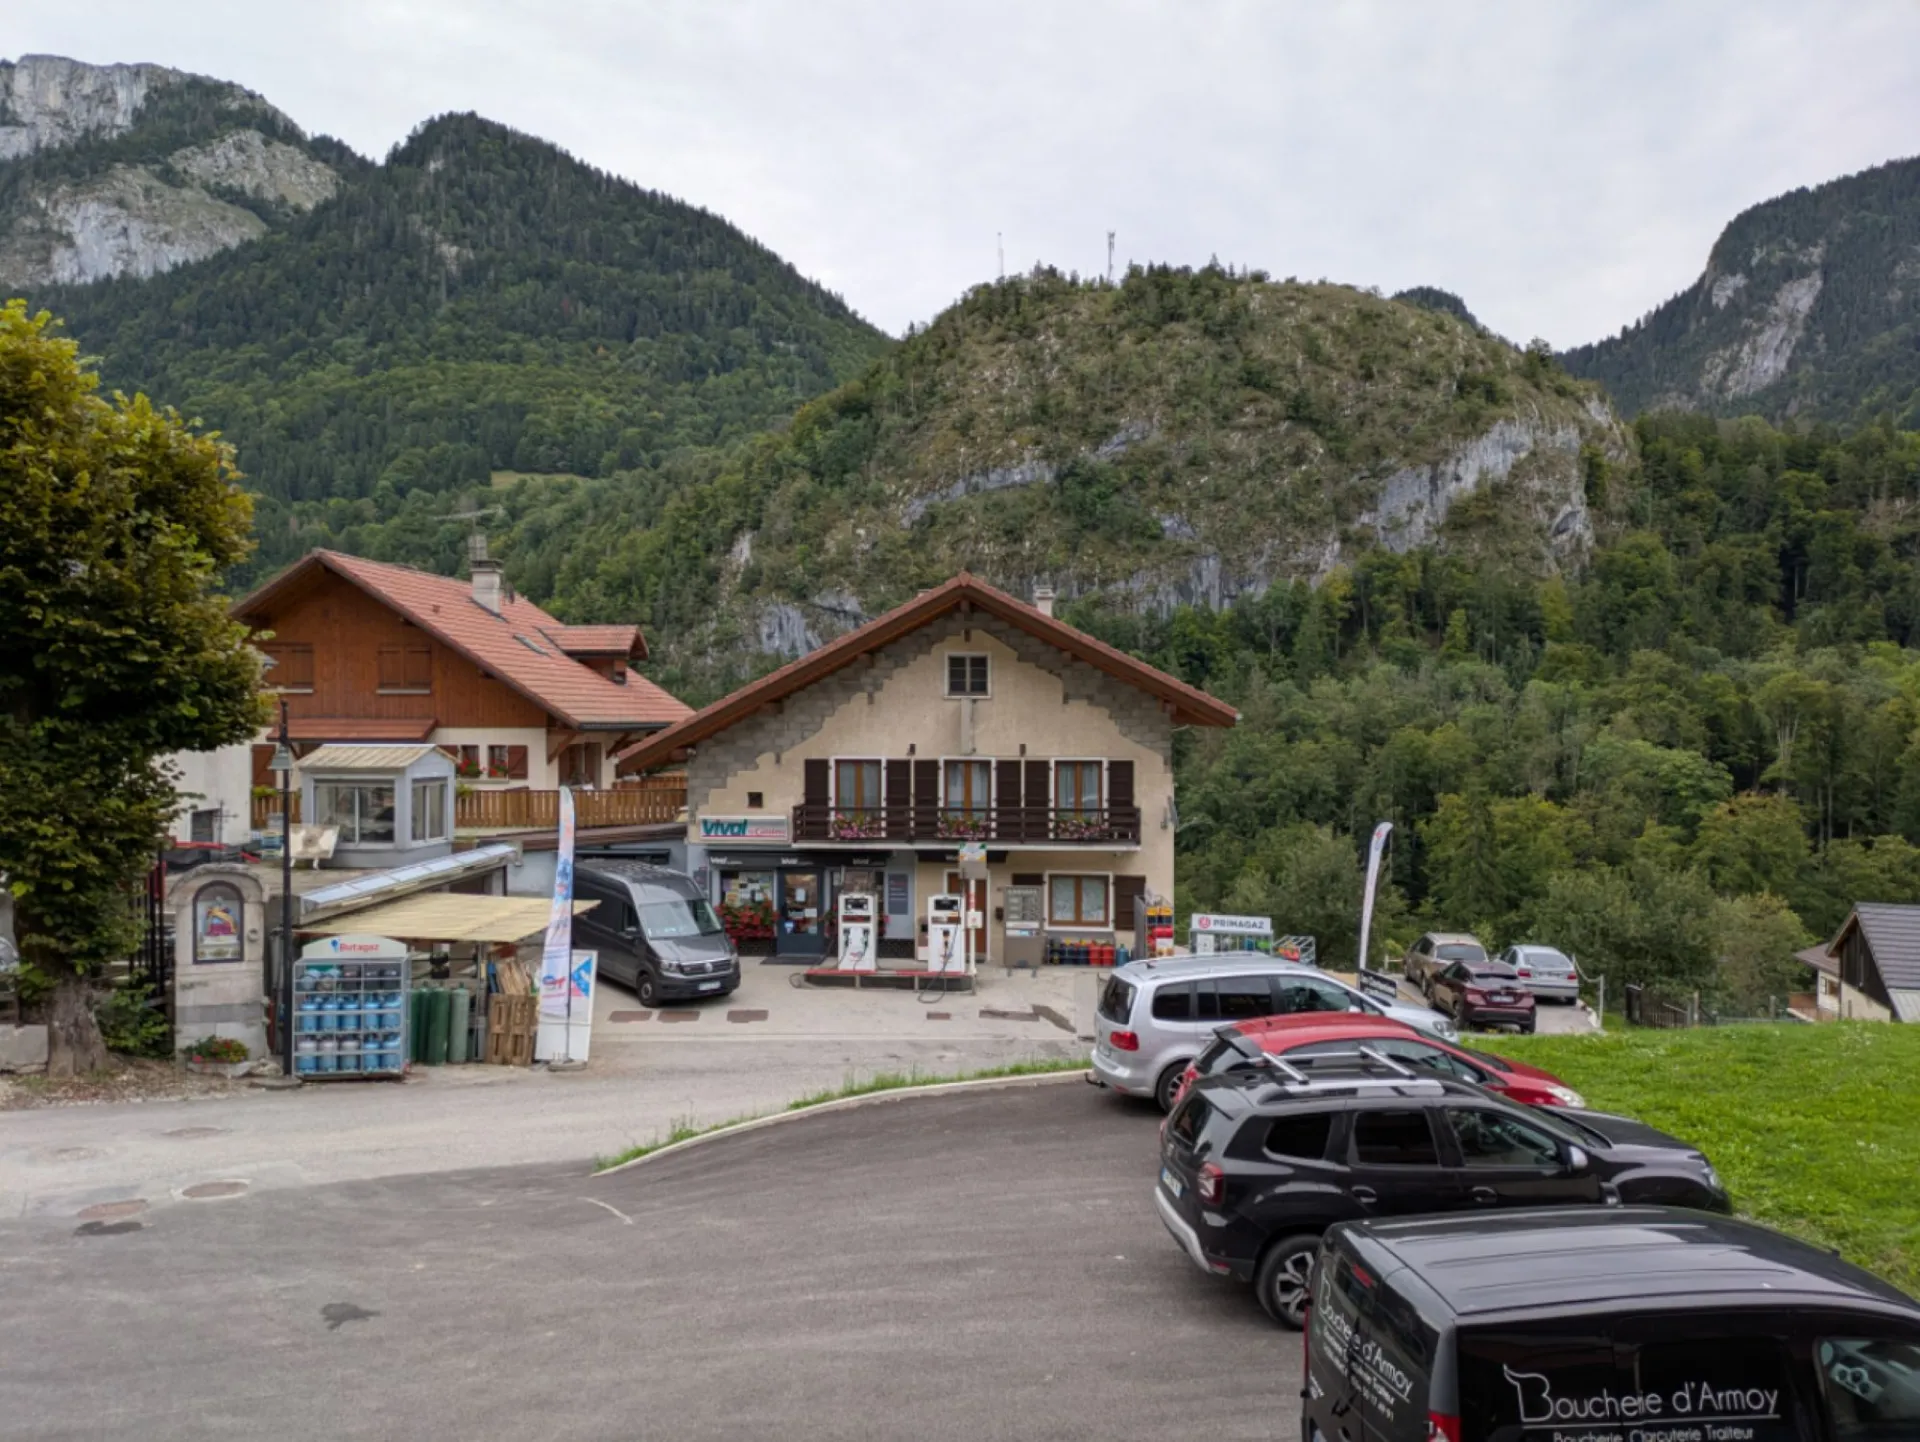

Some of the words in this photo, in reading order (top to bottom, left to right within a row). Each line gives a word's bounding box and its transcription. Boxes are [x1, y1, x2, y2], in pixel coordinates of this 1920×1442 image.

[703, 818, 748, 835] Vival
[1213, 918, 1265, 929] PRIMAGAZ
[340, 943, 380, 953] Butagaz
[1672, 1381, 1778, 1415] d'Armoy
[1704, 1424, 1754, 1440] Traiteur
